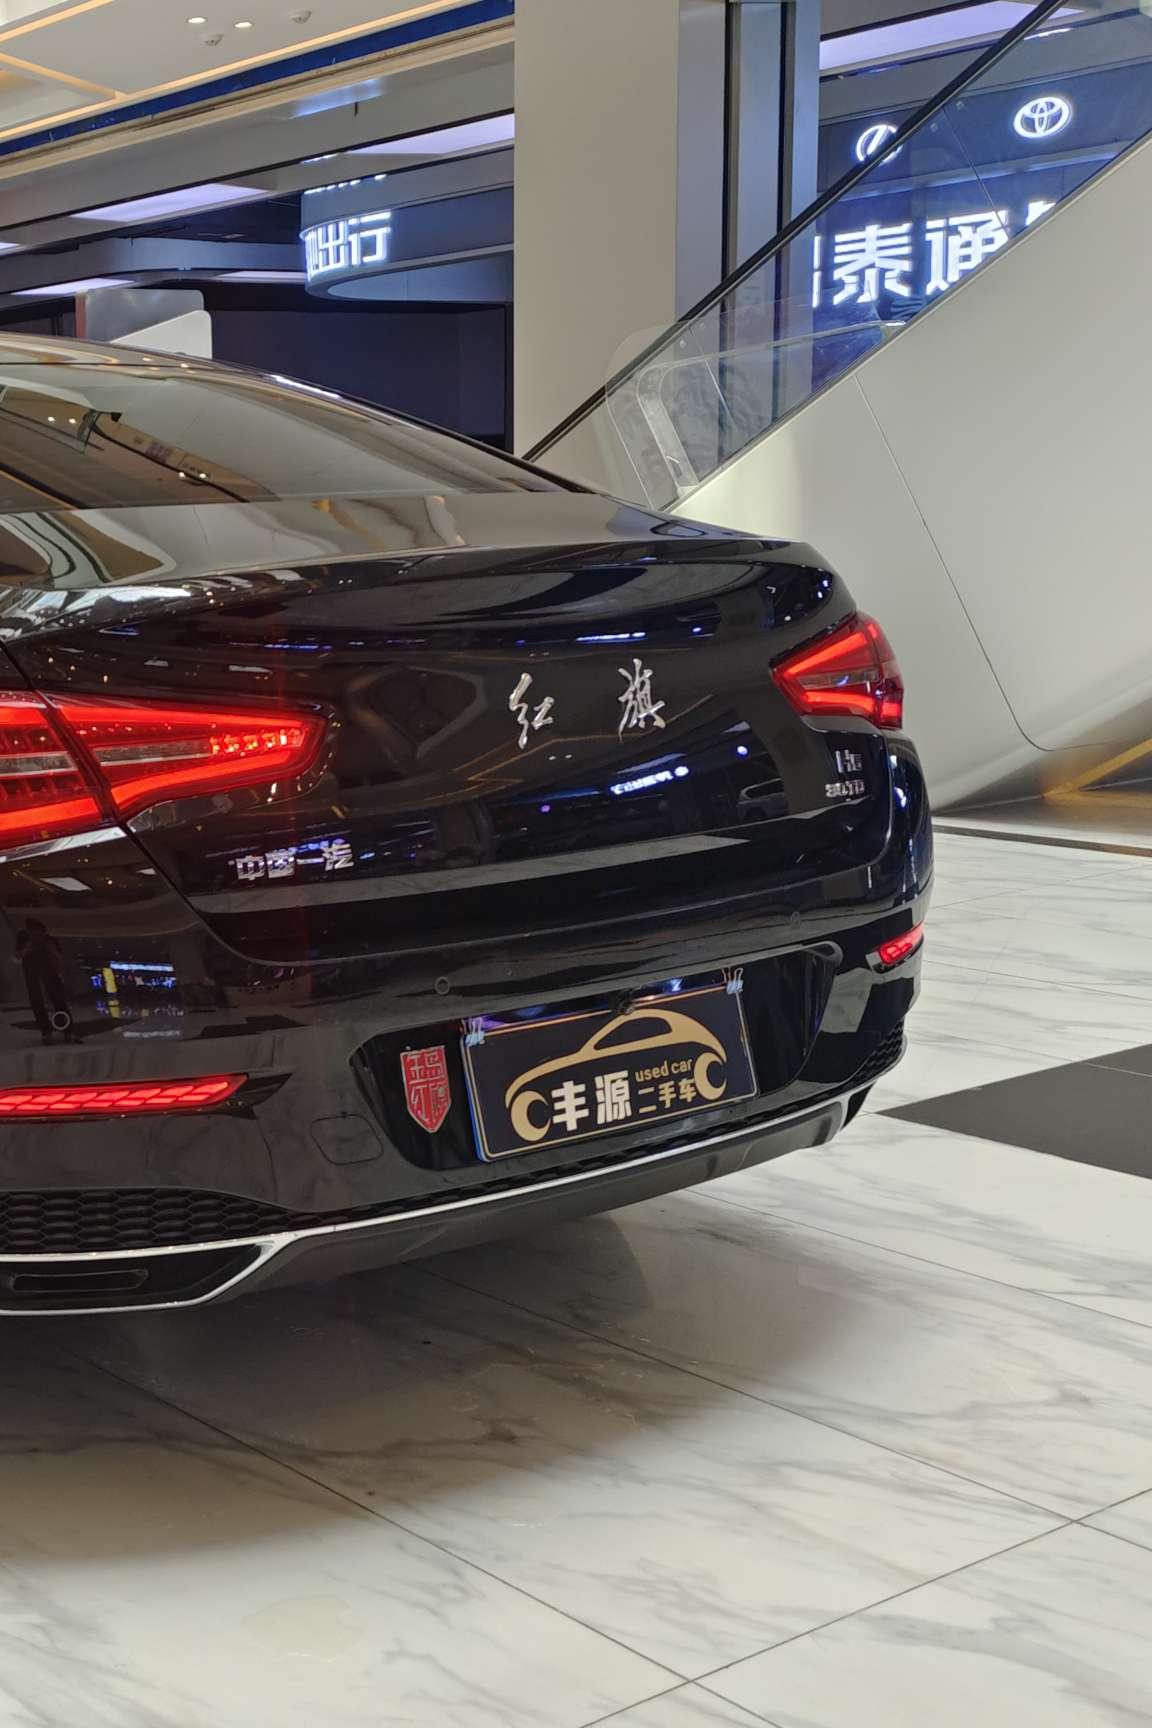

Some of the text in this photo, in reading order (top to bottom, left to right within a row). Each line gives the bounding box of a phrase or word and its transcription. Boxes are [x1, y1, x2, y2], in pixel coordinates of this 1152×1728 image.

[813, 200, 1056, 307] 泰通
[635, 1058, 693, 1082] used car
[551, 1070, 632, 1132] 丰源
[638, 1077, 697, 1114] 二手车
